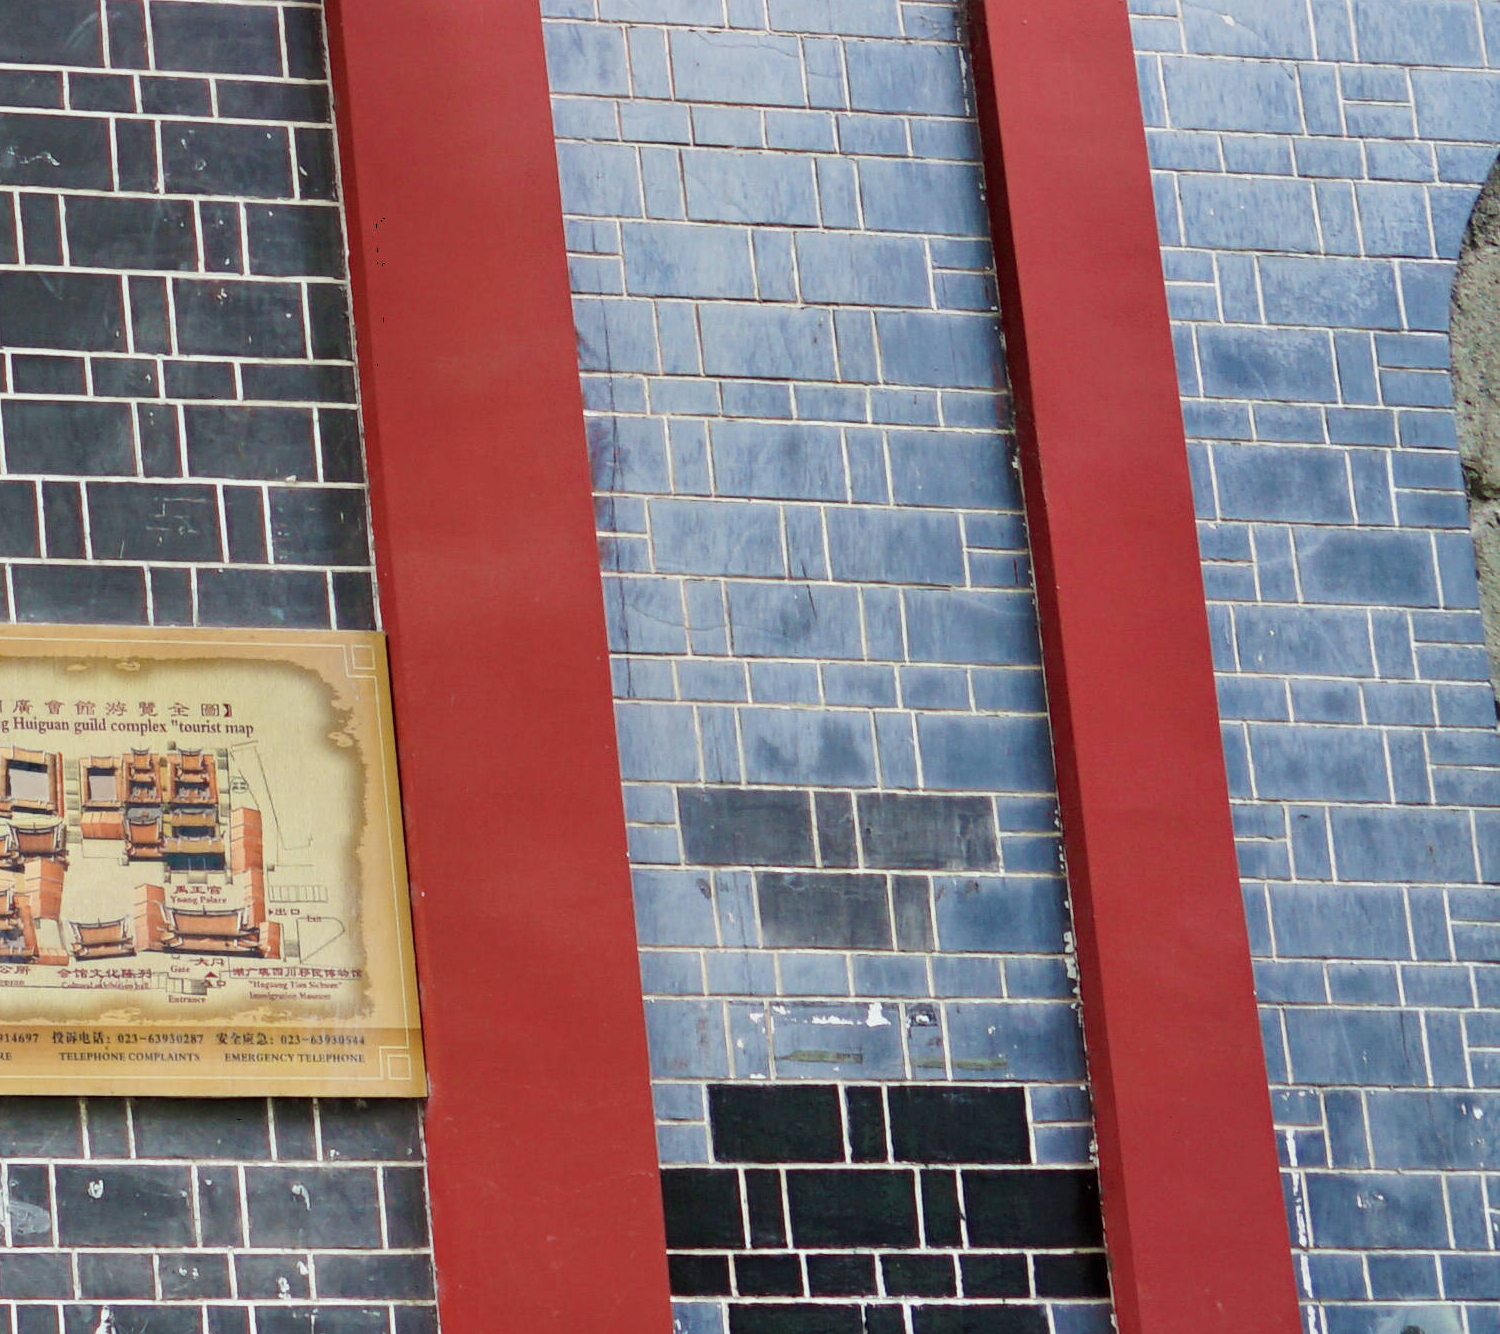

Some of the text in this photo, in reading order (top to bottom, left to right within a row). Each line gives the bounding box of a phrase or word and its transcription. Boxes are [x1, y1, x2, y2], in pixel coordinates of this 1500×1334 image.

[13, 717, 70, 733] Huiguan
[74, 717, 107, 734] guild
[110, 719, 168, 735] complex
[225, 723, 255, 737] map
[275, 907, 301, 916] 出口
[170, 965, 190, 973] Gate
[59, 1051, 201, 1062] TELEPHONE COMPLAINTS
[225, 1052, 365, 1063] EMERGENCY TELEPHONE
